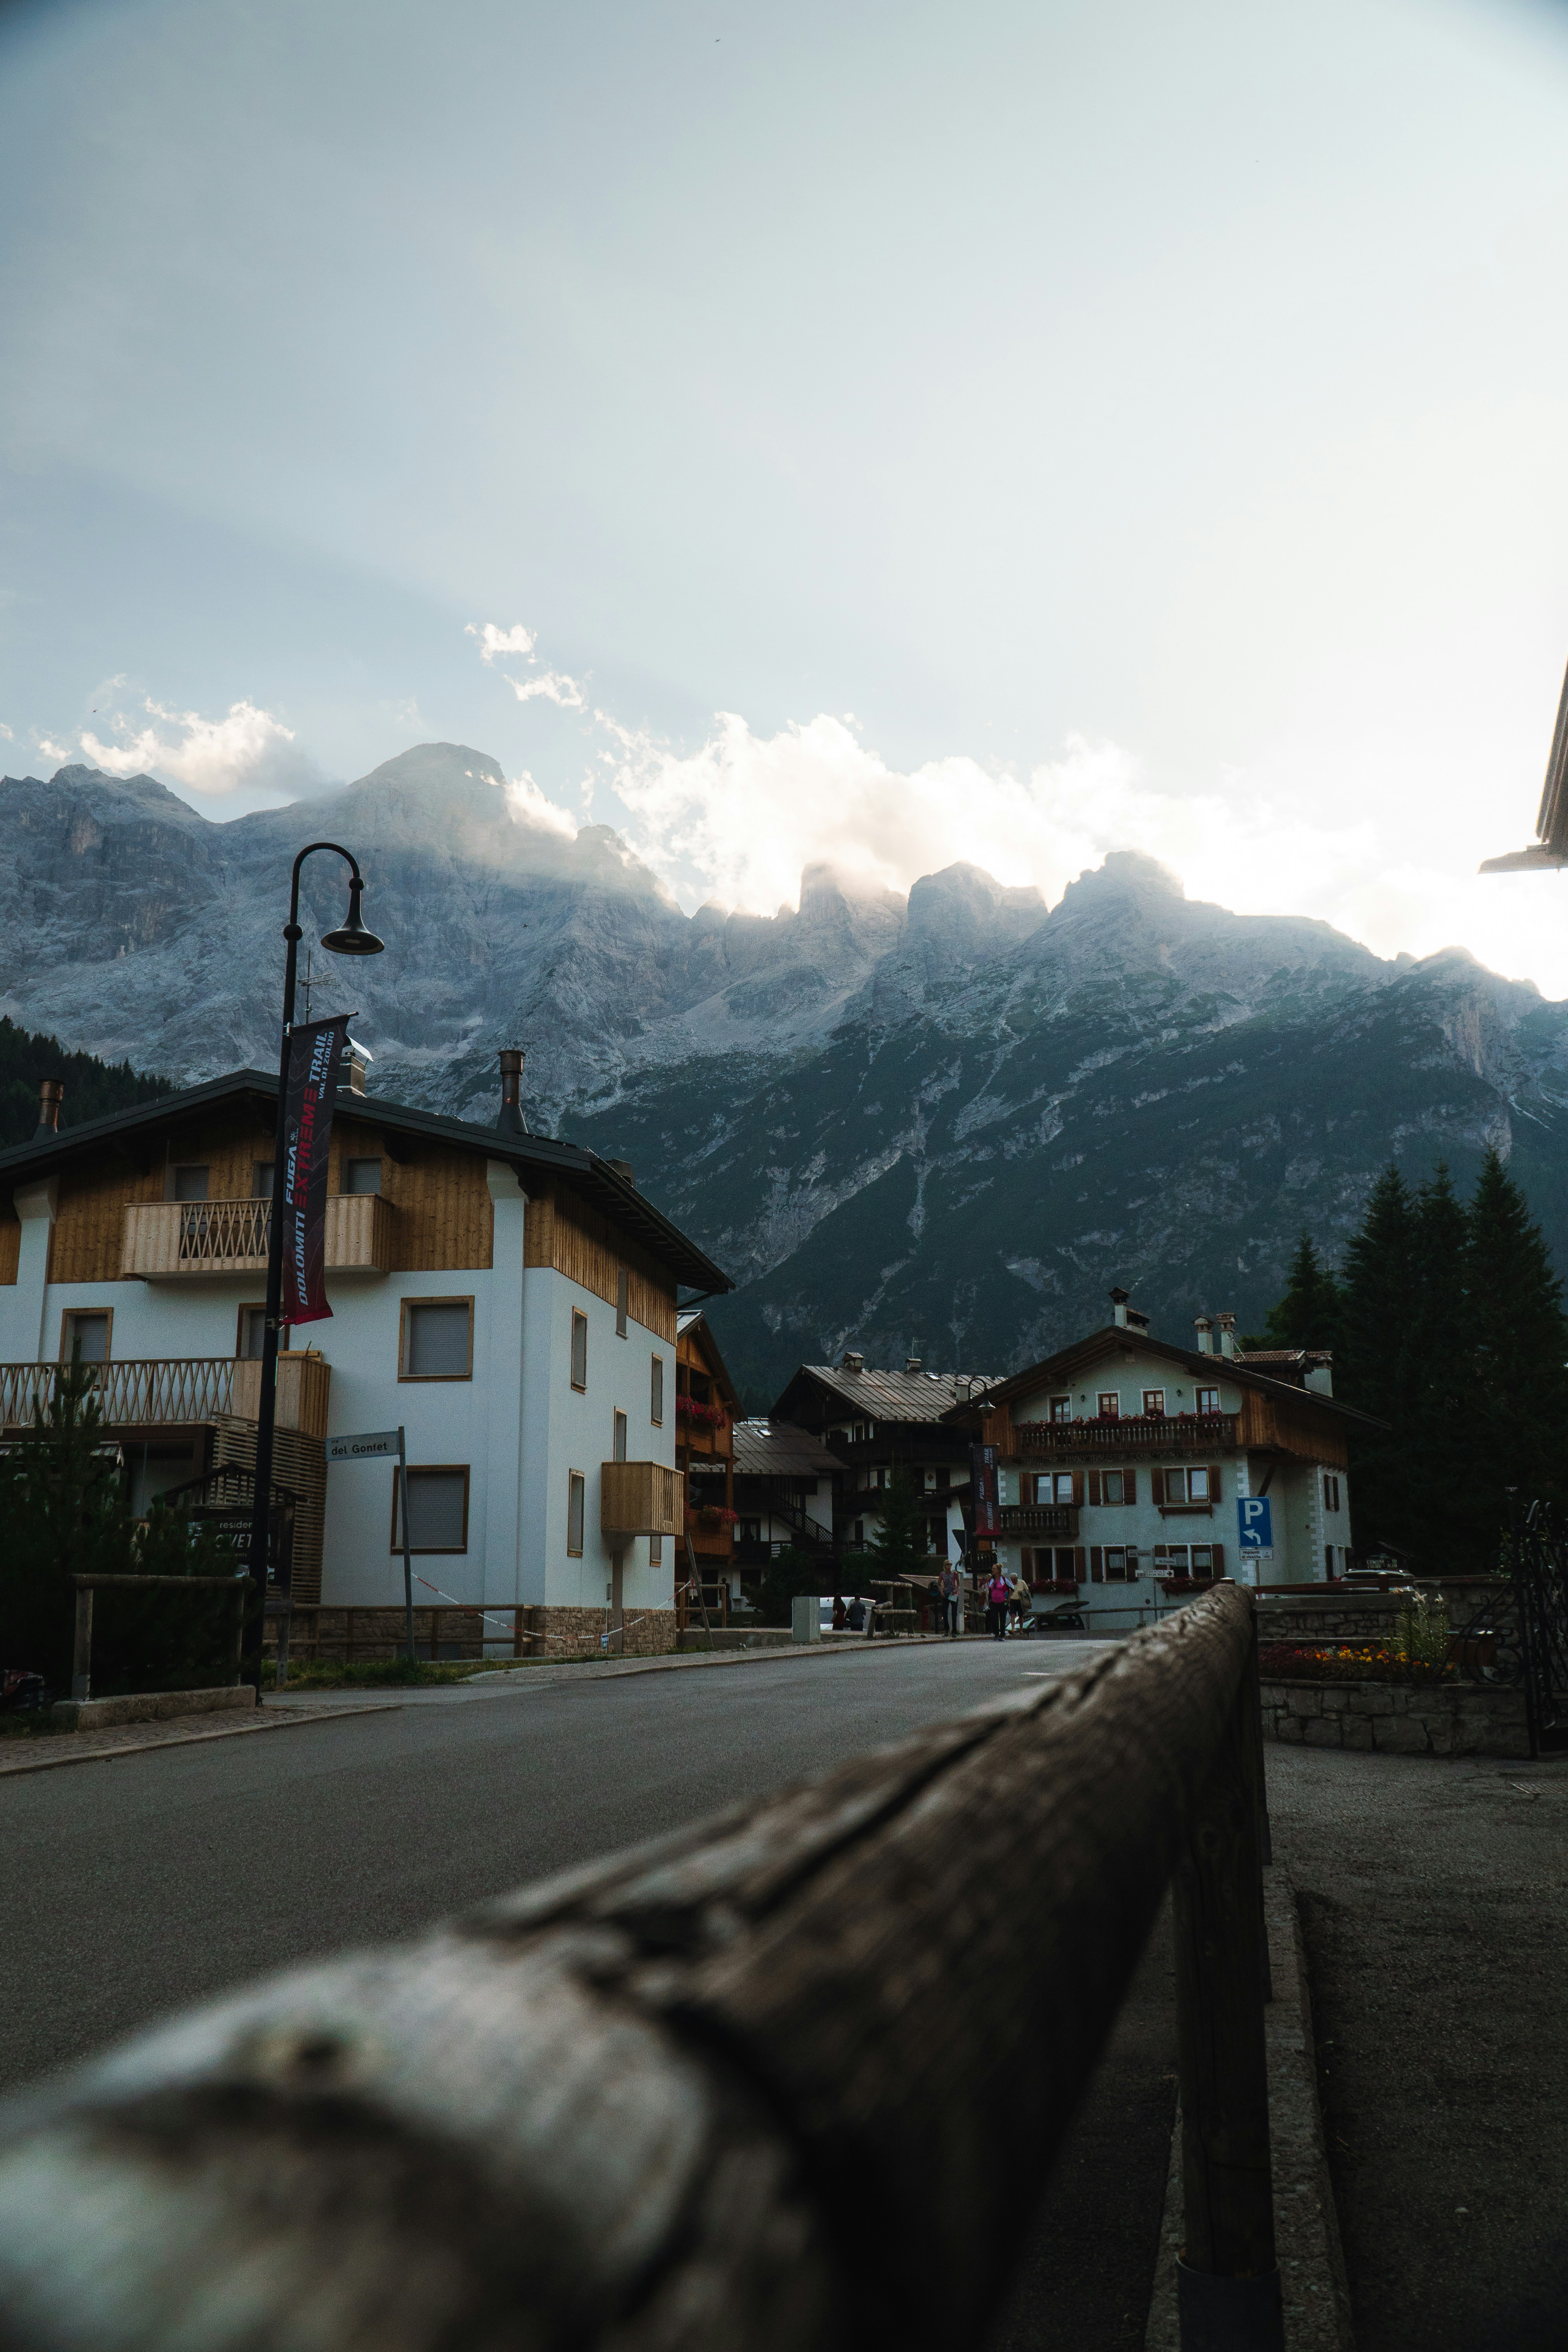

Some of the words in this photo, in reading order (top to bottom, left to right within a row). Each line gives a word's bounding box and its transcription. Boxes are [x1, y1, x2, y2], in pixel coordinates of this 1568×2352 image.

[309, 1032, 327, 1082] TRAIL
[324, 1031, 334, 1065] ZOLDO
[321, 1067, 328, 1079] DI
[295, 1087, 317, 1209] EXTREME
[285, 1146, 297, 1205] FUGA
[295, 1211, 308, 1306] DOLOMITI
[331, 1446, 347, 1455] del
[352, 1442, 388, 1453] Gonfet
[1244, 1500, 1263, 1524] P
